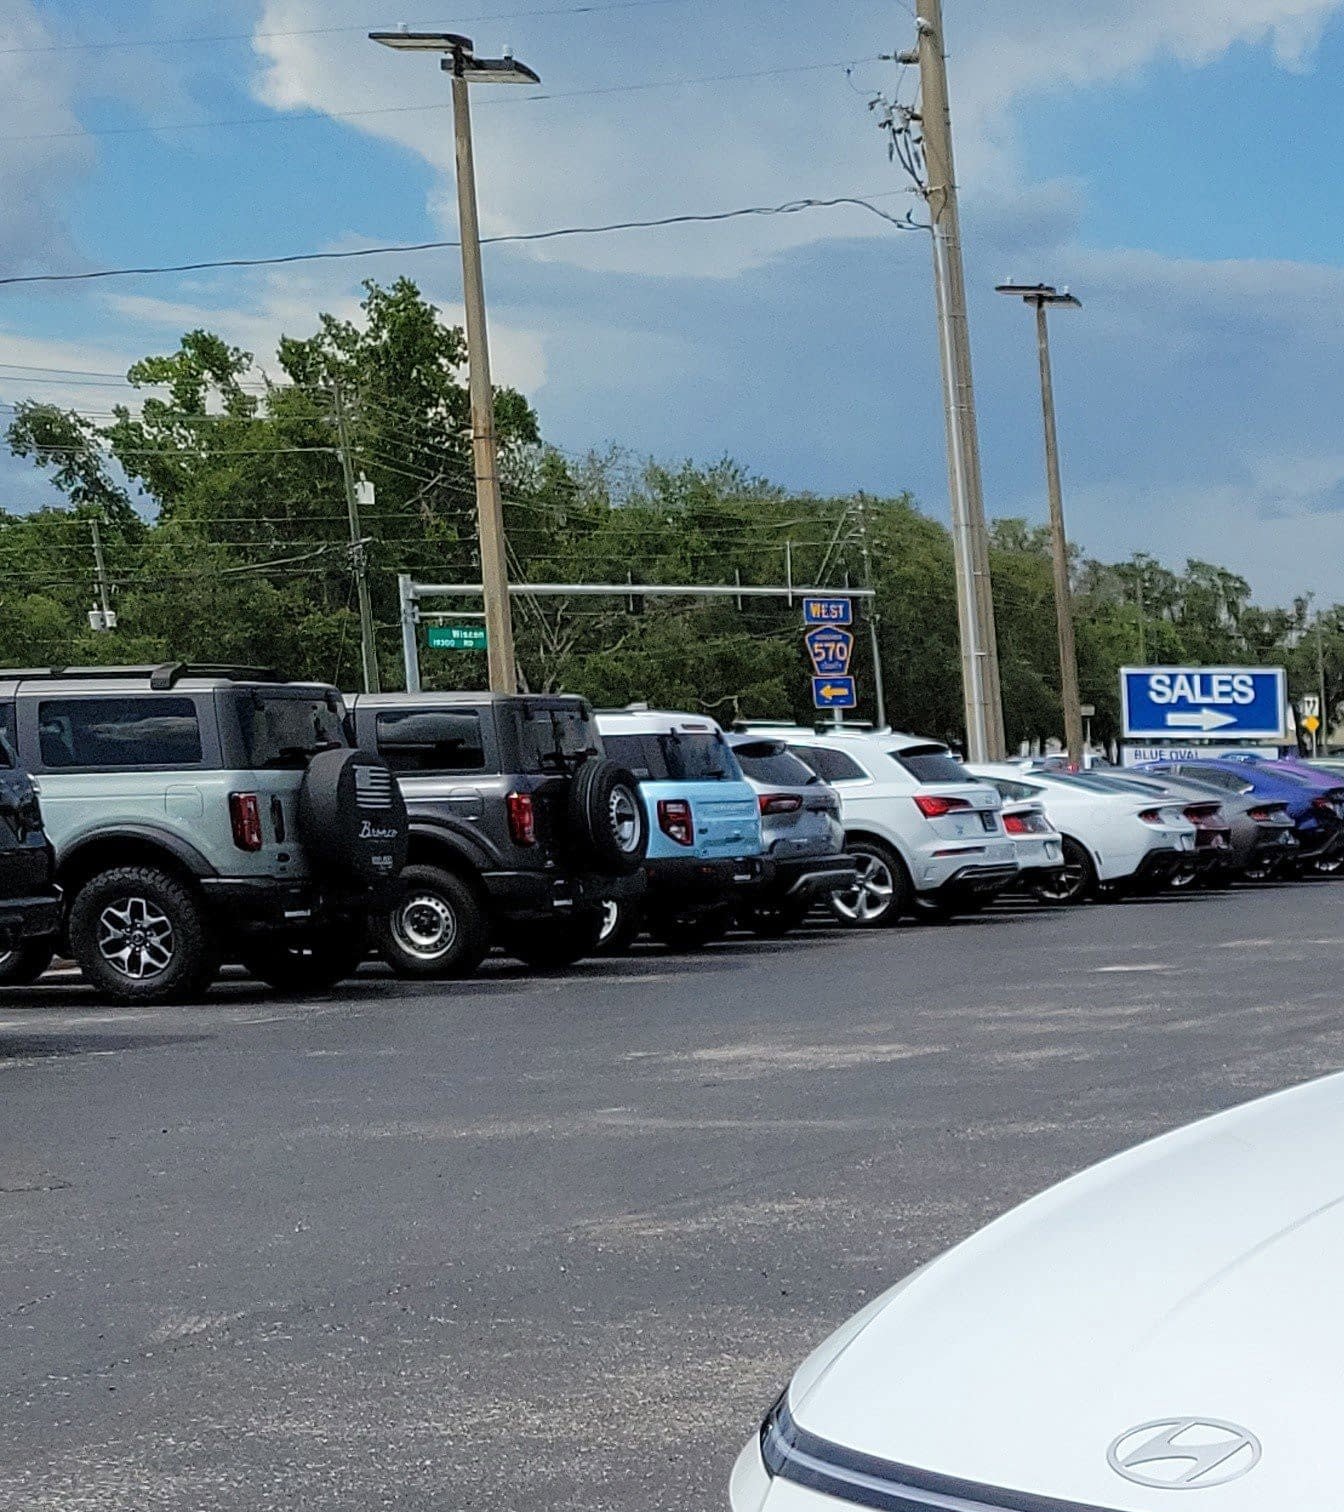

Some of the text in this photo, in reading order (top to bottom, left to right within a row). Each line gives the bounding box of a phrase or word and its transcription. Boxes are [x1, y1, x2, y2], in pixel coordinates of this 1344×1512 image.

[809, 602, 845, 619] WEST
[813, 641, 848, 662] 570
[1148, 673, 1256, 705] SALES
[1133, 748, 1168, 761] BLUE
